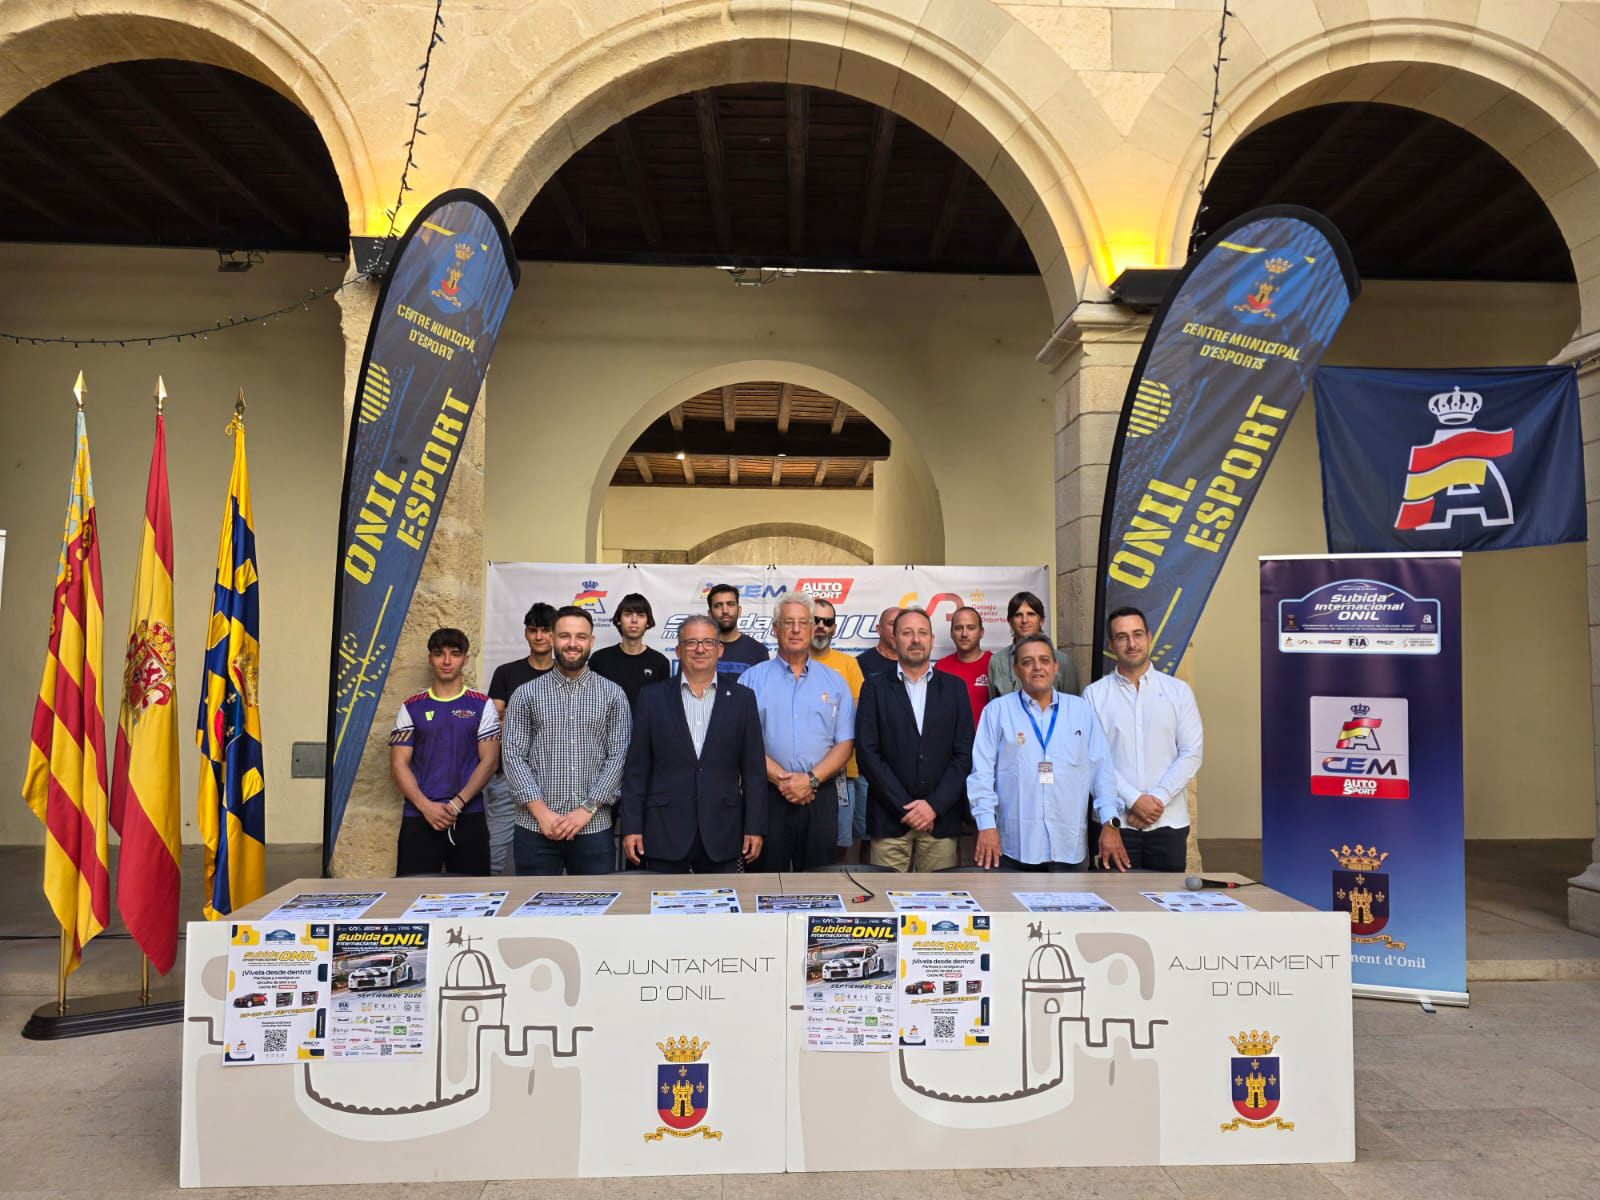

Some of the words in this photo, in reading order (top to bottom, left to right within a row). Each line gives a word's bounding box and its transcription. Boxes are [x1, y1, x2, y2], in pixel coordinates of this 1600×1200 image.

[397, 304, 431, 329] CENTRE
[431, 320, 476, 352] MUNICIPA
[1182, 322, 1231, 343] CENTRE
[1229, 332, 1300, 361] MUNICIPAL
[1200, 344, 1266, 370] D'ESPORTS
[396, 387, 470, 550] ESPORT
[1184, 394, 1287, 552] ESPORT
[344, 469, 408, 585] ONIL
[1108, 478, 1197, 589] ONIL
[801, 582, 842, 592] AUTO
[1330, 592, 1387, 603] Subida
[1314, 602, 1404, 611] Internacional
[1337, 610, 1380, 621] ONIL
[1321, 756, 1397, 775] CEM
[1342, 787, 1377, 795] SPORT
[1343, 779, 1377, 788] AUTO
[812, 925, 852, 933] Subida
[852, 926, 894, 938] ONIL
[338, 933, 381, 942] Subida
[380, 933, 425, 946] ONIL
[945, 941, 979, 951] ONIL
[279, 950, 318, 961] ONIL
[1169, 955, 1340, 971] AJUNTAMENT
[1384, 954, 1426, 969] d'Onil
[595, 957, 775, 975] AJUNTAMENT
[640, 985, 726, 1001] D'ONIL
[1212, 982, 1293, 996] D'ONIL
